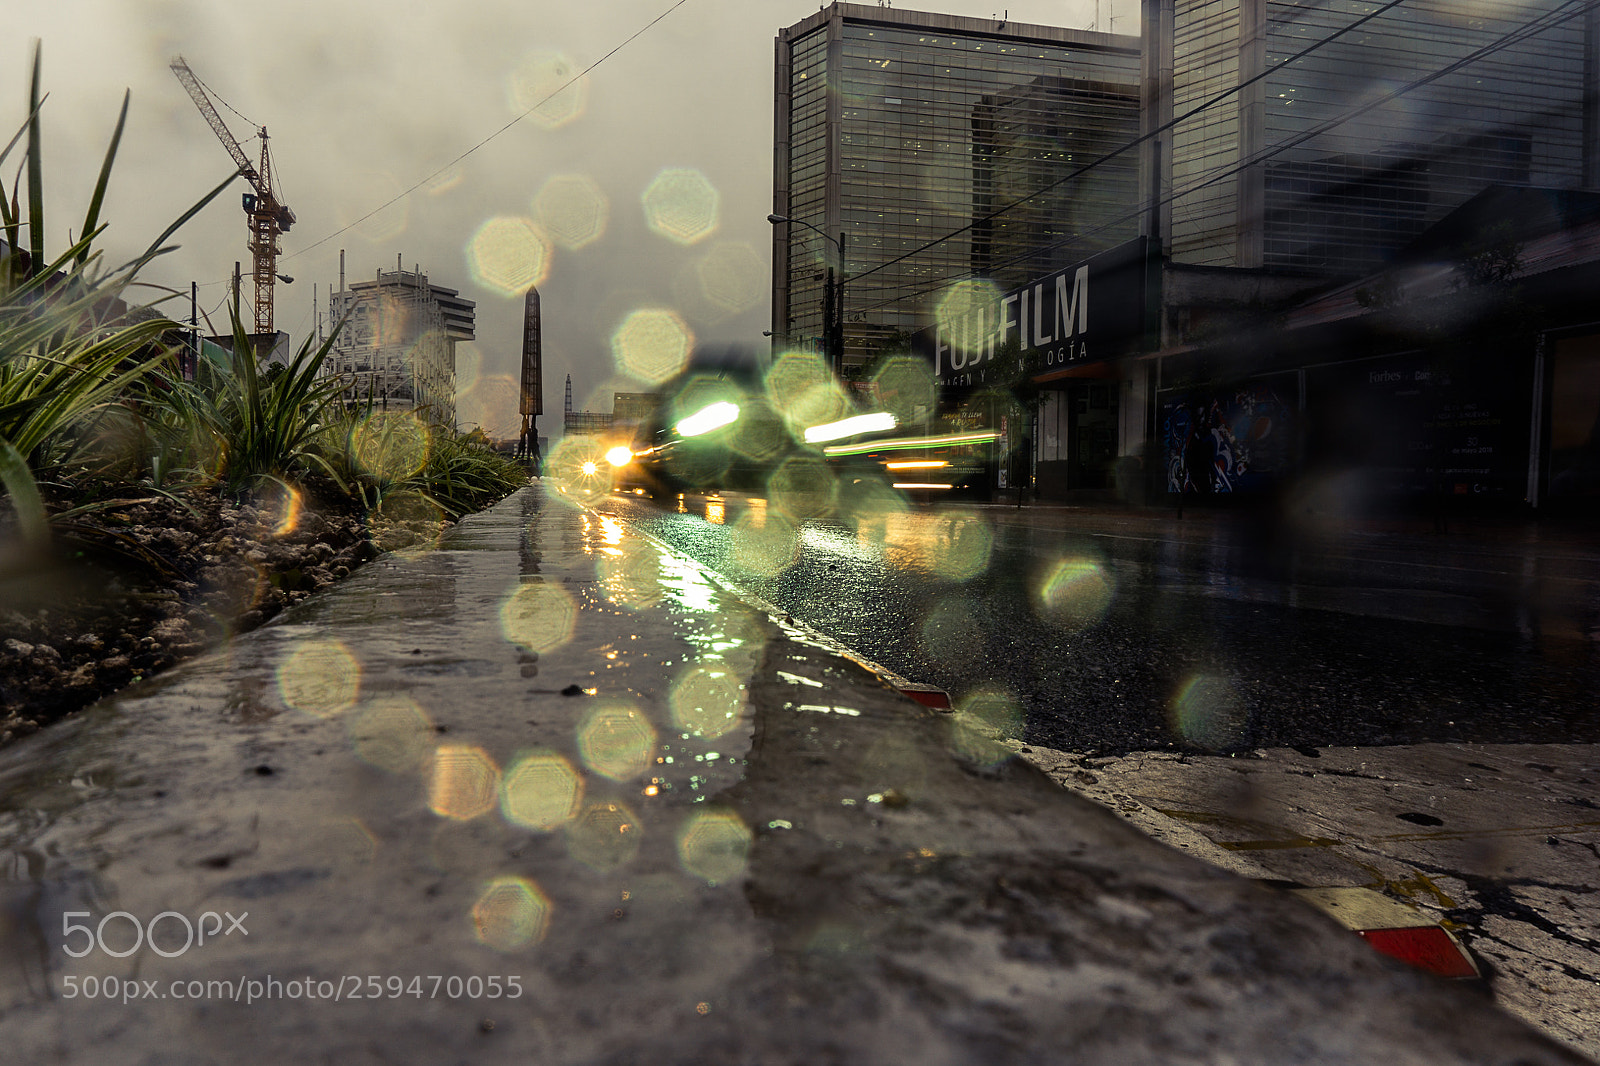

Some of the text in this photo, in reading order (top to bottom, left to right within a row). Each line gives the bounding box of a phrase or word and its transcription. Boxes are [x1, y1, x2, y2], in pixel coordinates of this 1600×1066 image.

[935, 264, 1089, 377] FUJIFILM
[934, 372, 973, 387] MAGEN
[980, 368, 986, 383] Y
[1369, 370, 1401, 384] Forbes
